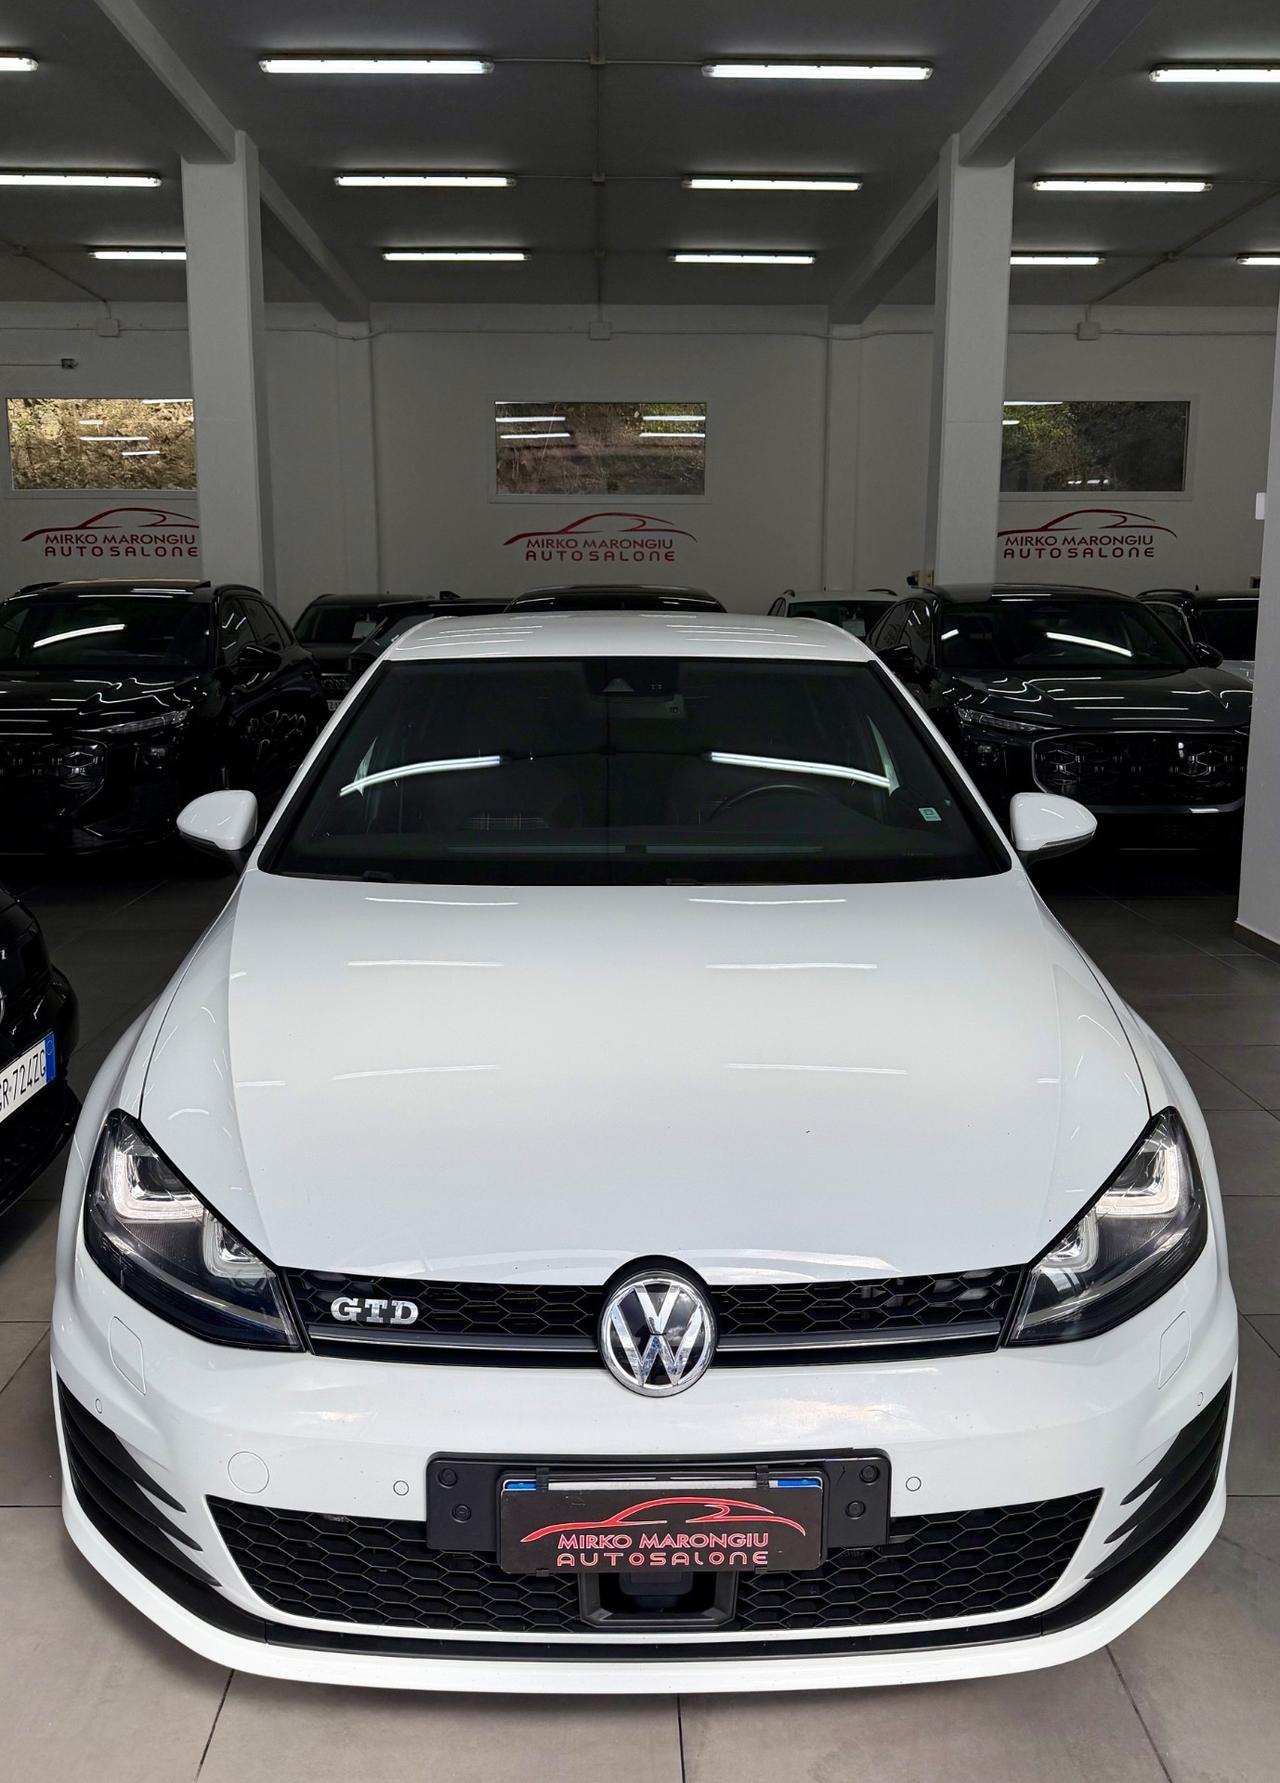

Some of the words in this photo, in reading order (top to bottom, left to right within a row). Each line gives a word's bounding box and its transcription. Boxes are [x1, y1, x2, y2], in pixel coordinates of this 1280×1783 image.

[45, 534, 98, 545] MIRKO
[102, 534, 195, 545] MARONGIU
[526, 538, 578, 549] MIRKO
[583, 539, 673, 549] MARONGIU
[1005, 535, 1057, 546] MIRKO
[1062, 535, 1153, 546] MARONGIU
[44, 546, 199, 557] AUTOSALONE
[525, 551, 675, 562] AUTOSALONE
[1003, 547, 1155, 559] AUTOSALONE
[330, 1296, 419, 1326] GTD
[608, 1279, 704, 1388] VW
[557, 1533, 632, 1550] MIRKO
[638, 1532, 769, 1549] MARONGIU
[556, 1551, 769, 1567] AUTOSALONE
